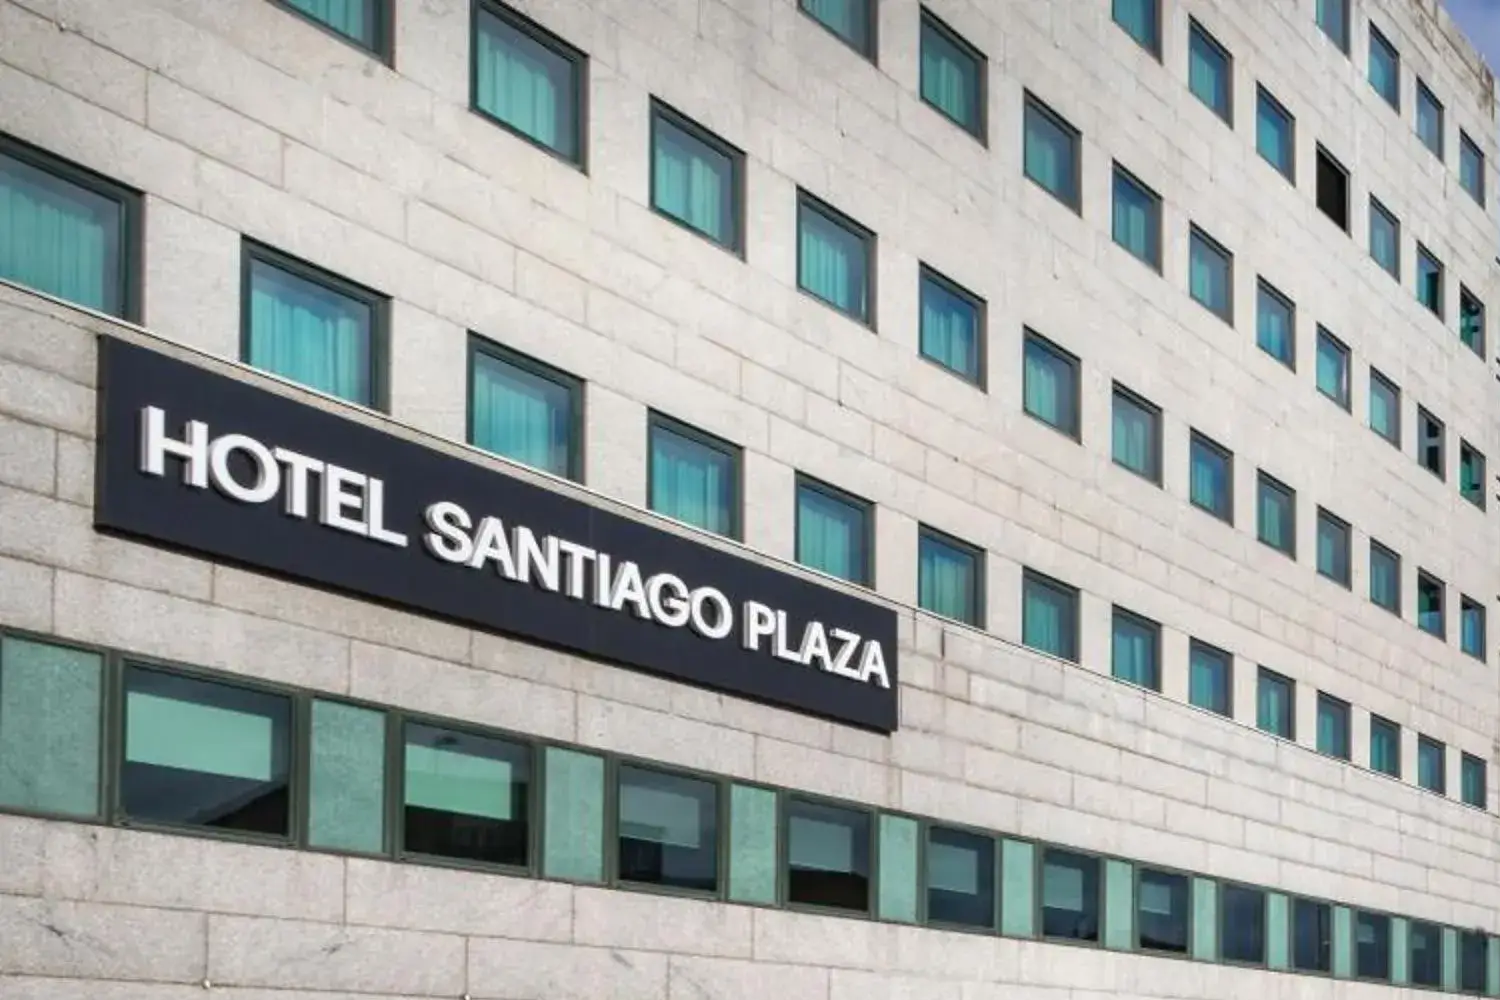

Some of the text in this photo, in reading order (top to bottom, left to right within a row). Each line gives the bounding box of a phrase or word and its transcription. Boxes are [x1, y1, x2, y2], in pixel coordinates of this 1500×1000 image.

[139, 404, 890, 689] HOTEL SANTIAGO PLAZA
